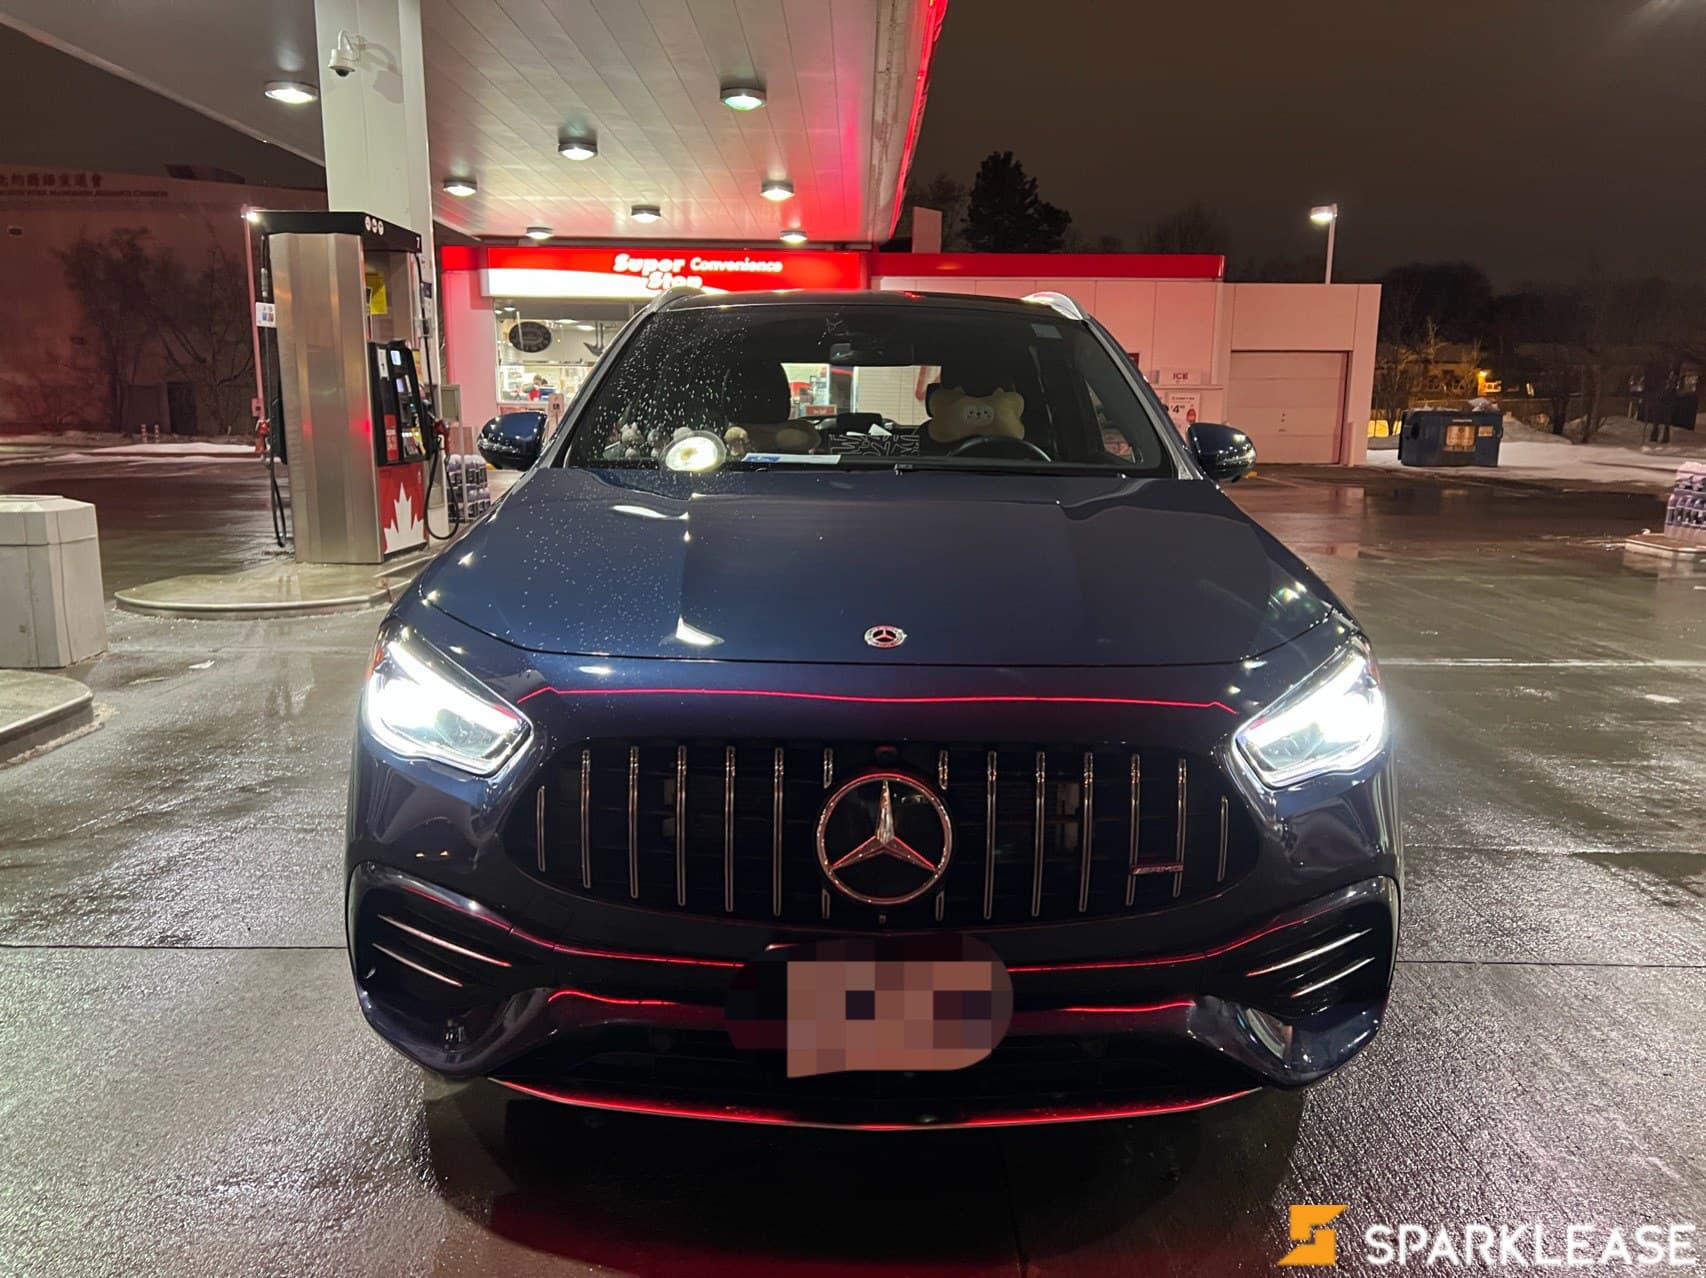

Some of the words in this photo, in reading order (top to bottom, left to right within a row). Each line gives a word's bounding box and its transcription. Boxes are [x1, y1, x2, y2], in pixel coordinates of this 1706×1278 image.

[613, 253, 686, 276] Super
[690, 256, 783, 273] Convenience
[1172, 372, 1189, 380] ICE
